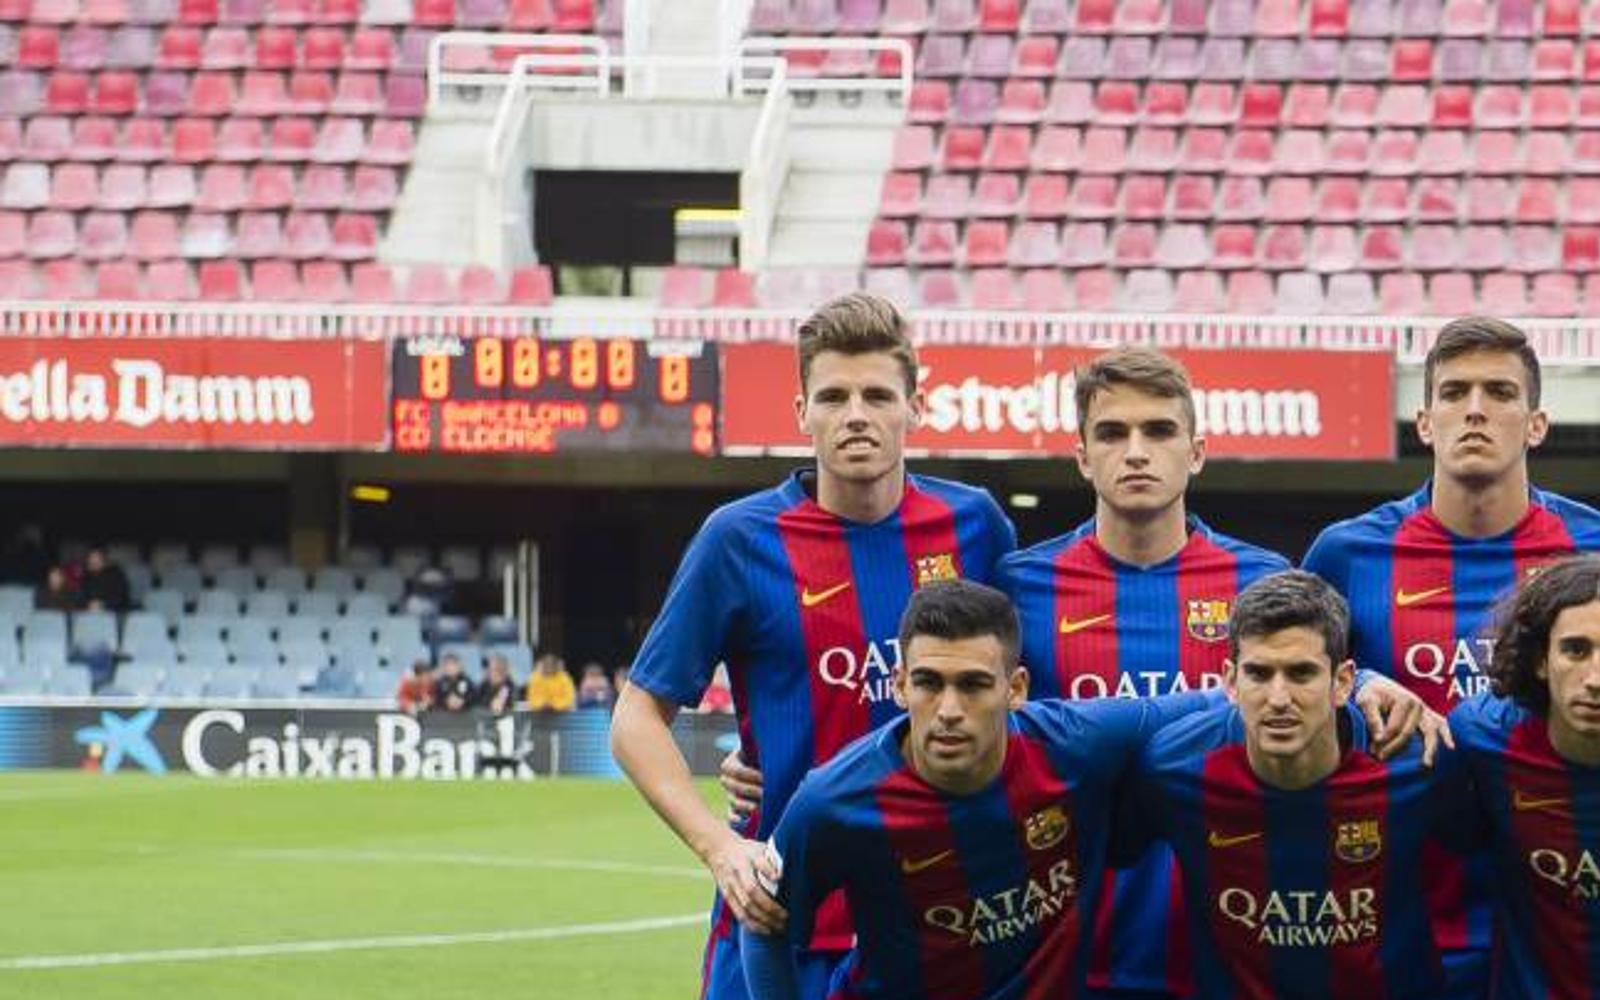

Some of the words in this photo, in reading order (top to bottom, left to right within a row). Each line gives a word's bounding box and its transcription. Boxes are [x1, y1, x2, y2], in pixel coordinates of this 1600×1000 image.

[0, 358, 108, 422] ella
[111, 358, 313, 426] Damm
[917, 368, 1079, 434] strell
[1192, 388, 1321, 436] mm
[819, 638, 903, 690] QAT
[1404, 638, 1497, 684] QAT
[182, 708, 536, 781] CaixaBank
[925, 859, 1076, 934] QATAR
[1219, 887, 1377, 929] QATAR
[1257, 921, 1377, 946] AIRWAYS
